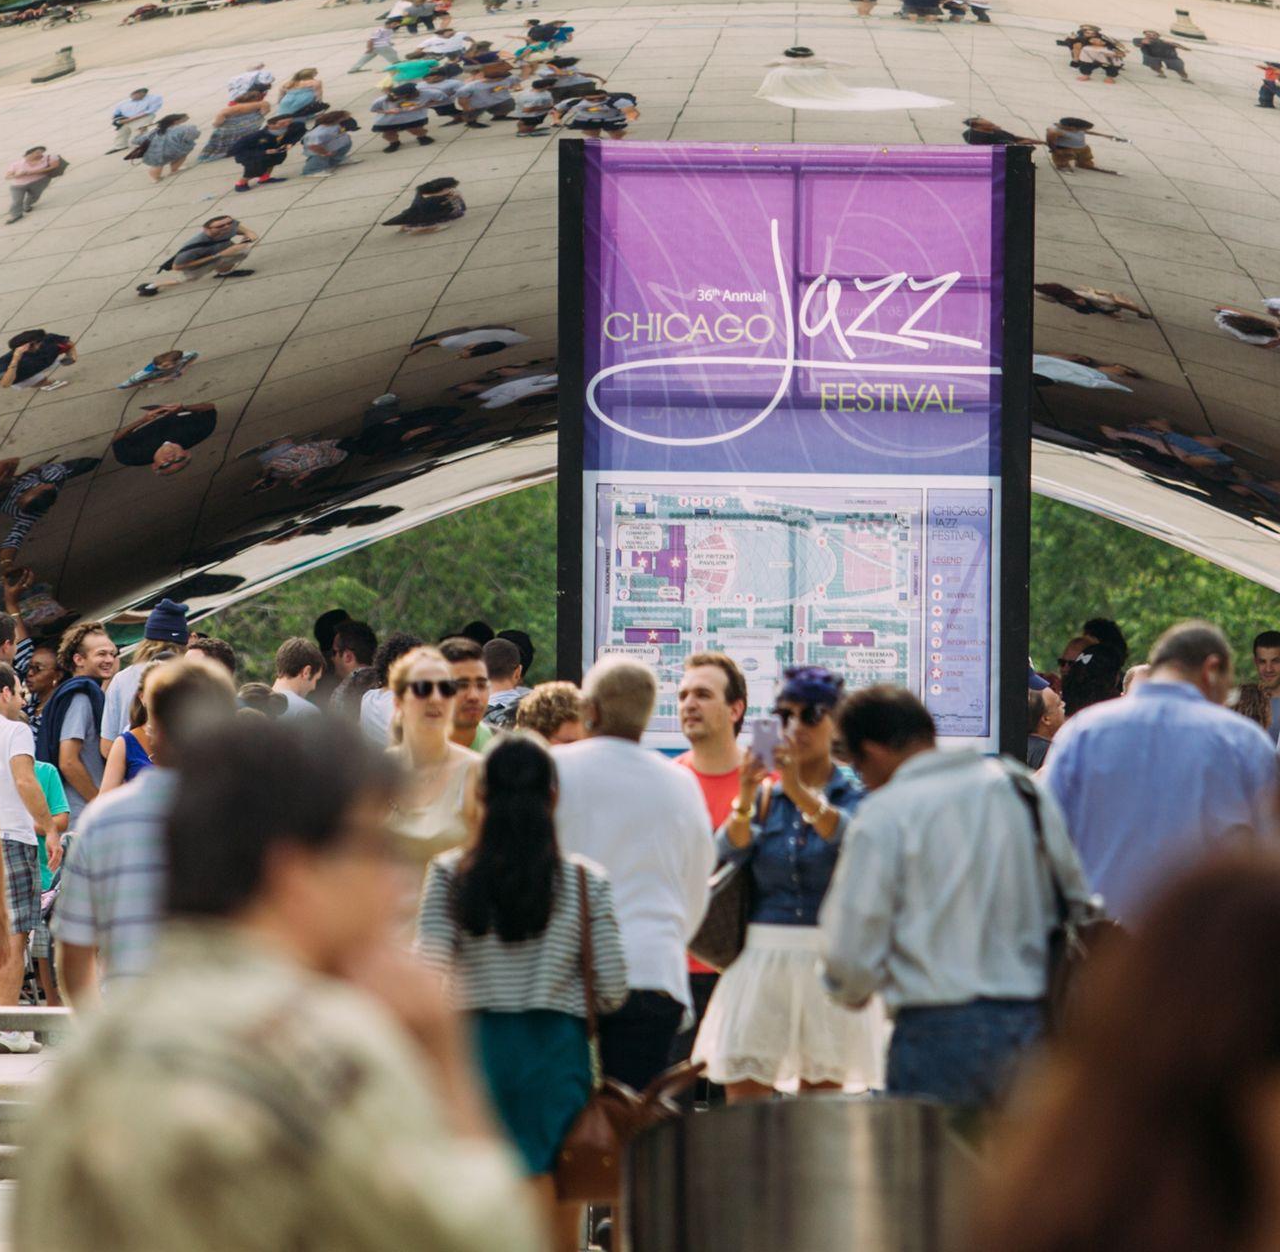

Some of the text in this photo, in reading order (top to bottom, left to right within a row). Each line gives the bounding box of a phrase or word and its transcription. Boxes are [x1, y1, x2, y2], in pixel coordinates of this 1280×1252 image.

[697, 289, 767, 303] 36th Annual
[603, 312, 775, 343] CHICAGO
[820, 382, 964, 414] FESTIVAL
[932, 505, 987, 517] CHICAGO
[933, 517, 958, 529] JAZZ
[931, 529, 976, 541] FESTIVAL
[932, 556, 962, 564] LEGEND
